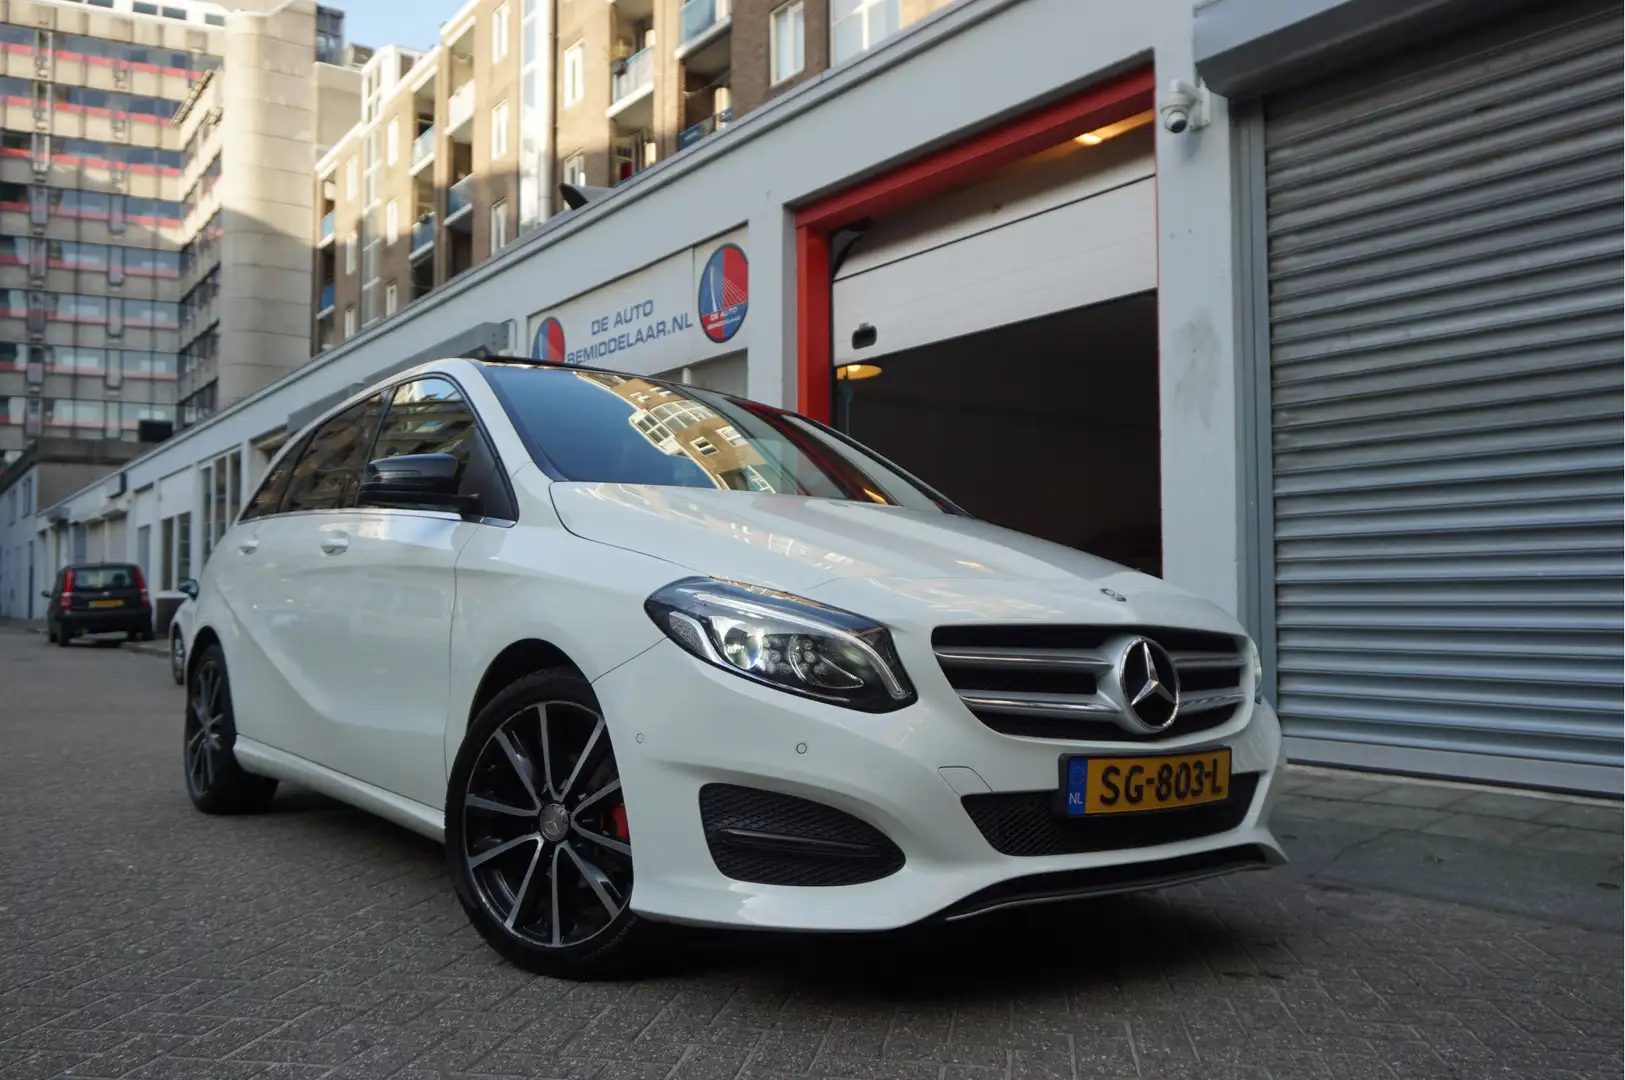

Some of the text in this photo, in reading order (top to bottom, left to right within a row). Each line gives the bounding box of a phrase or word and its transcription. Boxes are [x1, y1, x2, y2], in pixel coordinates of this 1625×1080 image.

[591, 299, 654, 336] DE AUTO
[710, 306, 738, 321] DE AUTO
[567, 312, 694, 364] BEMIDDELAAR.NL
[1069, 758, 1223, 806] NL SG-803-L
